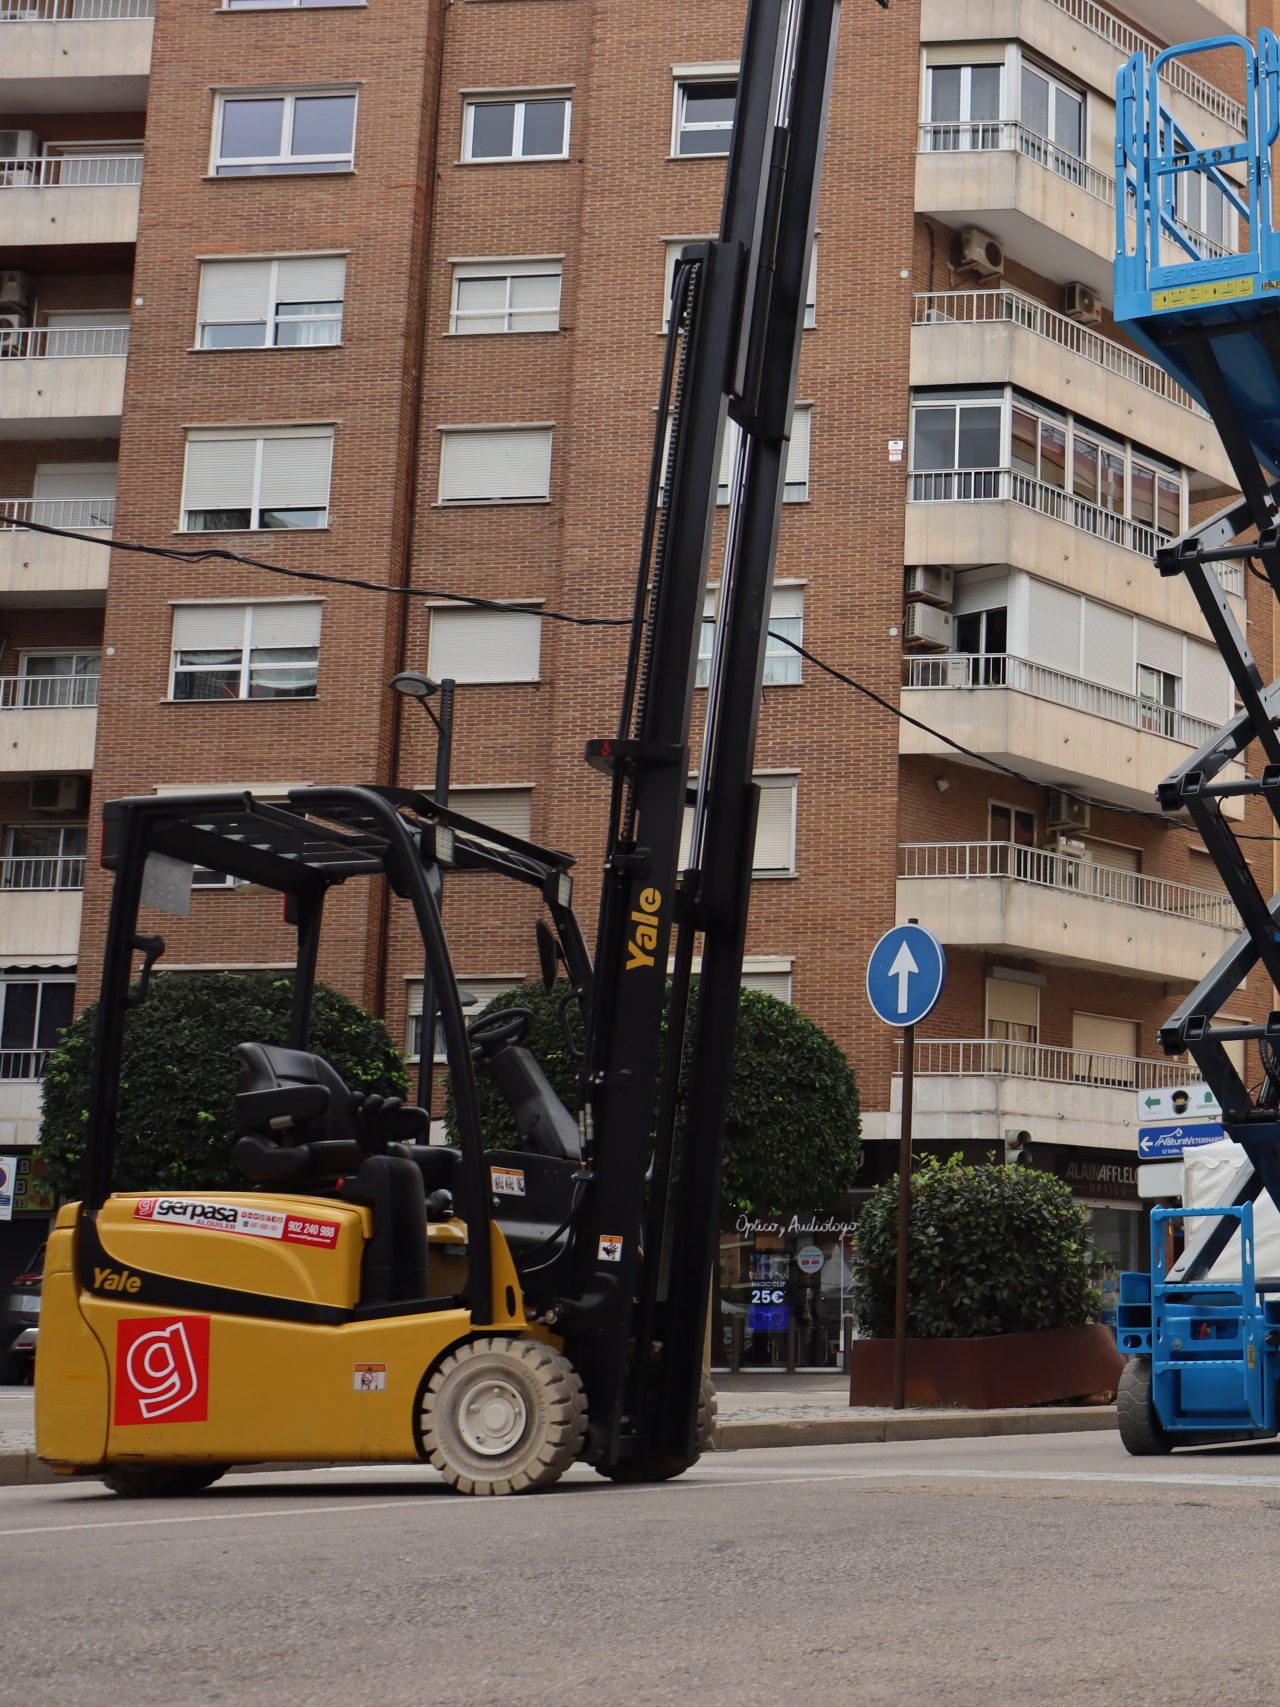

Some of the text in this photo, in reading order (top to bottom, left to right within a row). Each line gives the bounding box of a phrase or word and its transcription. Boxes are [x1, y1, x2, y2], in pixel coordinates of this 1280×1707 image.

[1196, 146, 1236, 165] 391
[626, 887, 662, 970] Yale
[156, 1199, 238, 1224] gerpasa
[195, 1218, 237, 1231] ALQUILER
[287, 1219, 303, 1233] 902
[303, 1222, 319, 1236] 240
[319, 1224, 336, 1238] 988
[736, 1210, 860, 1241] Óptico y Audiólogo
[92, 1267, 142, 1293] Yale
[126, 1321, 198, 1419] g
